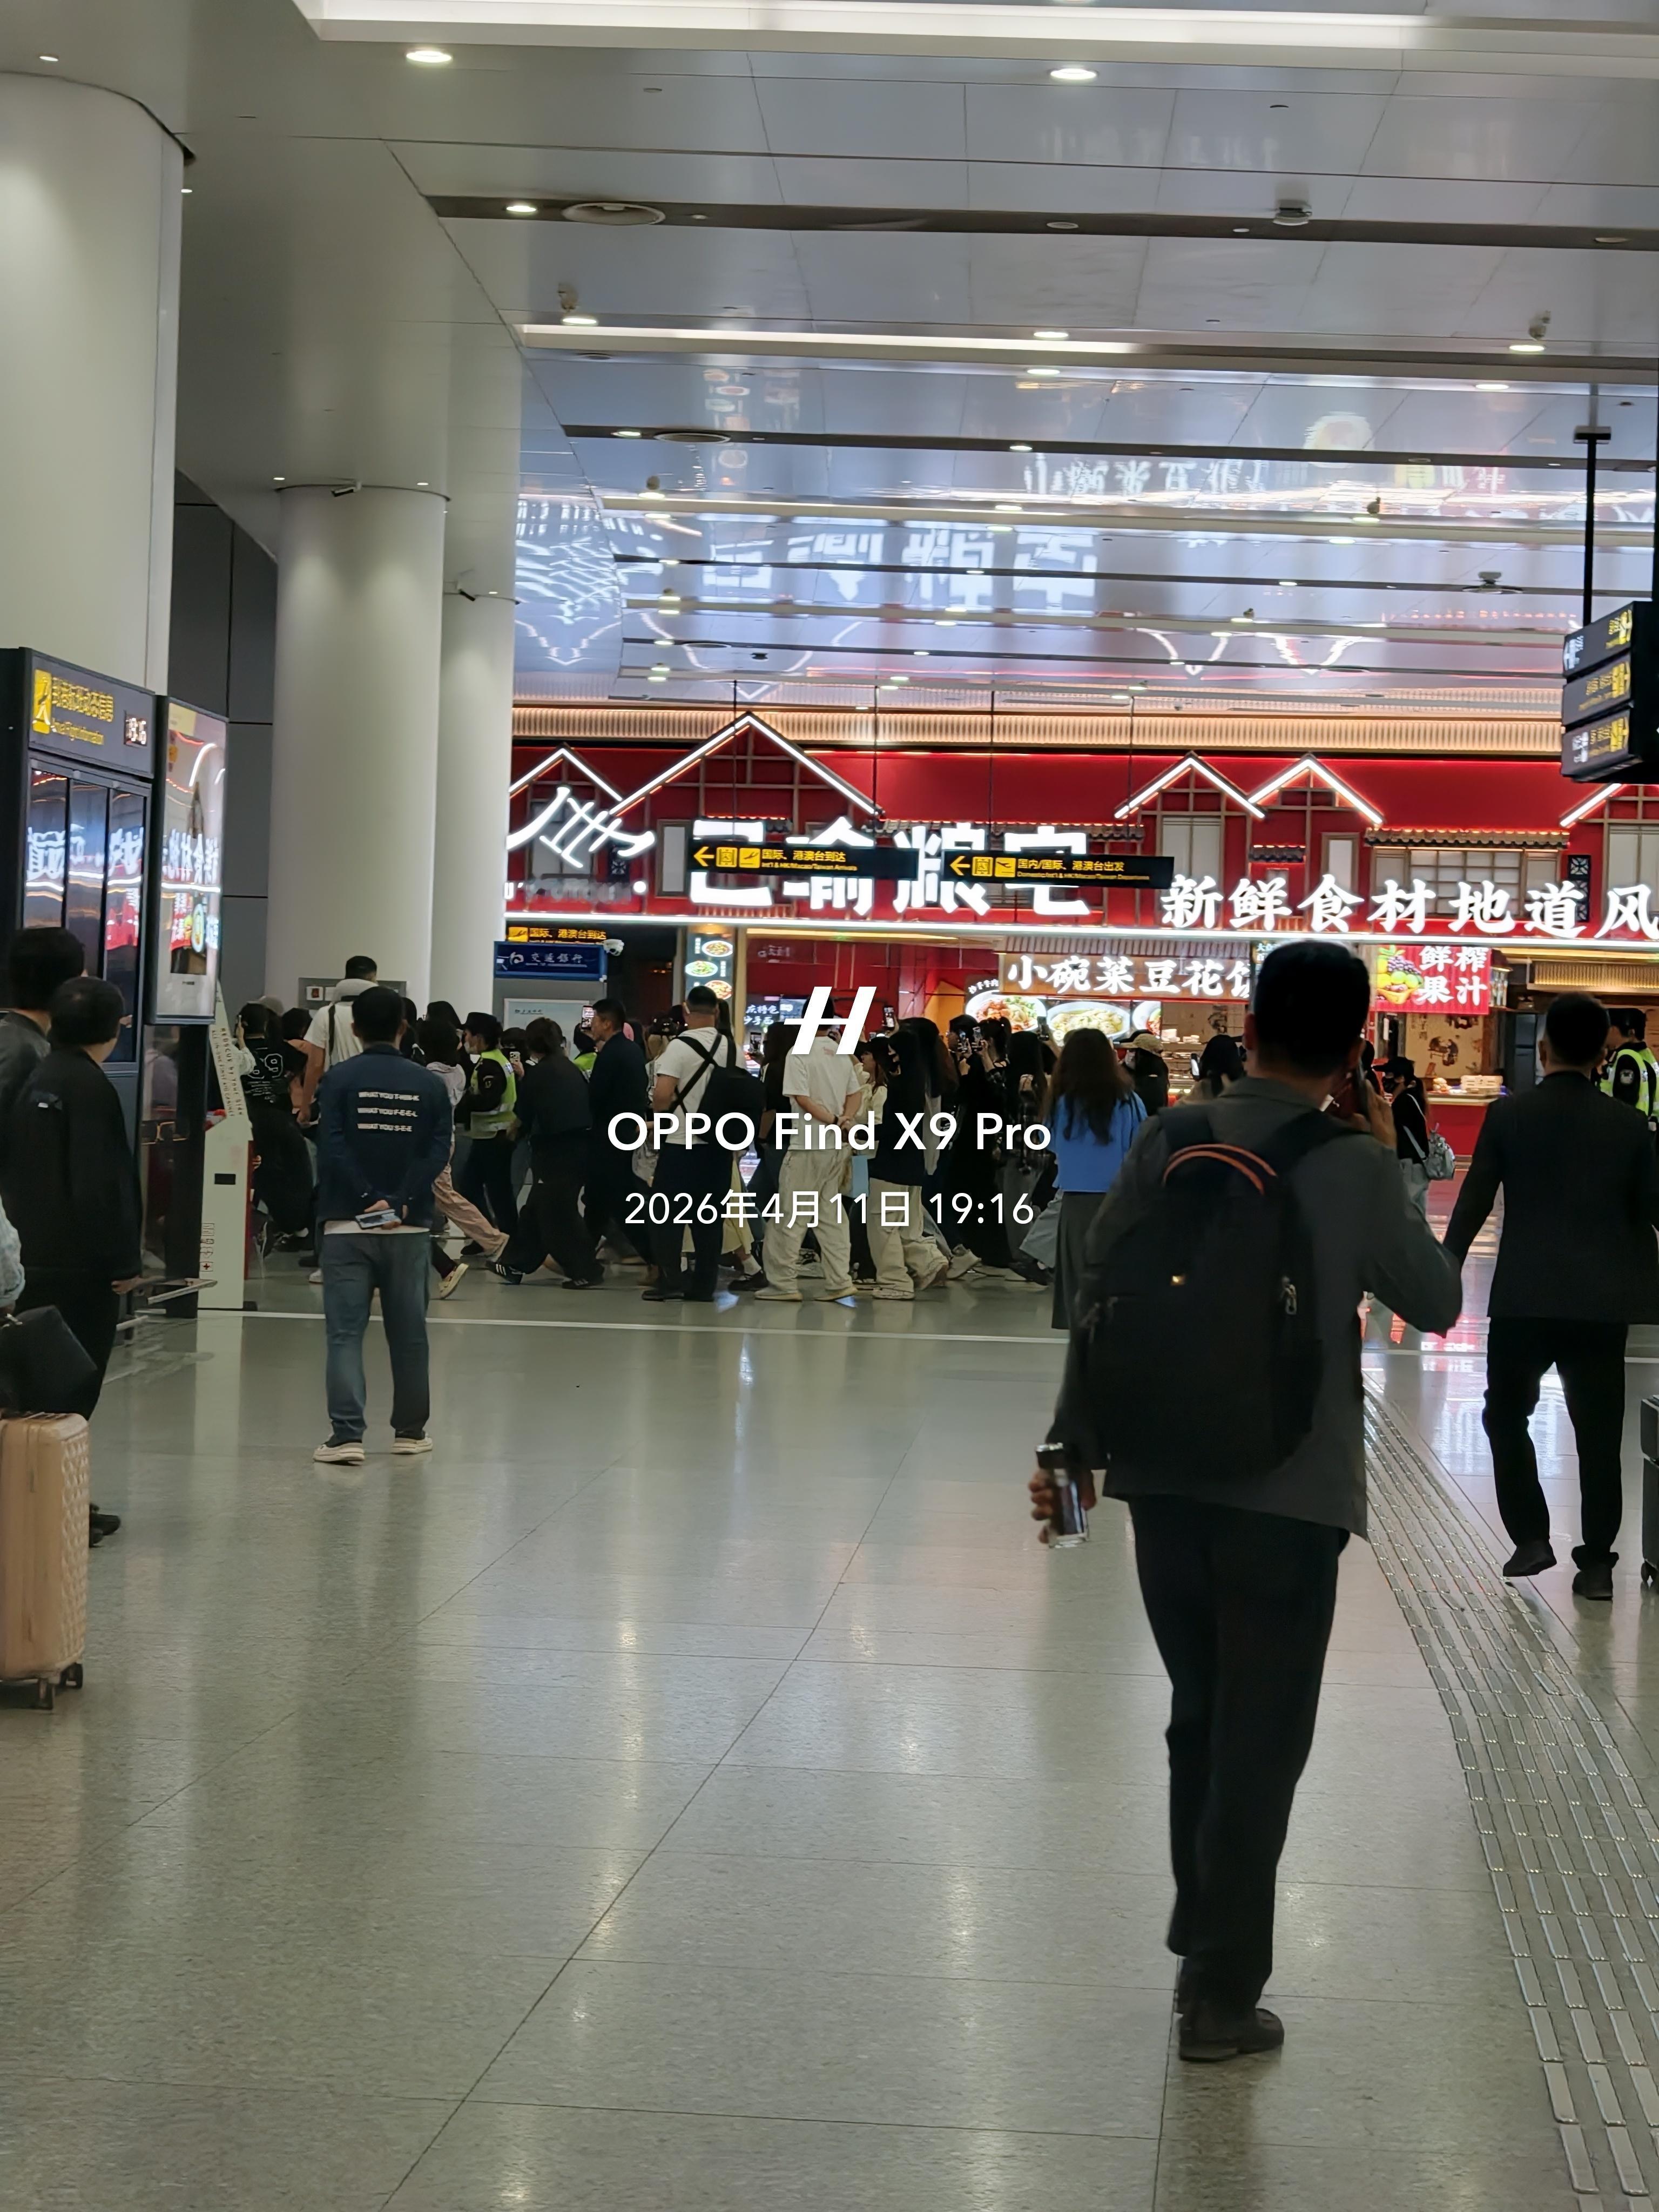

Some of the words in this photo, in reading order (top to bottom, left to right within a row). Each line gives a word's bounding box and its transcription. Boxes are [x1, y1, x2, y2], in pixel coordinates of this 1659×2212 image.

[761, 849, 846, 862] 国际、港澳台到达
[1161, 874, 1659, 940] 新鲜食材地道风
[1418, 946, 1489, 973] 鲜榨
[1415, 975, 1488, 1006] 果汁
